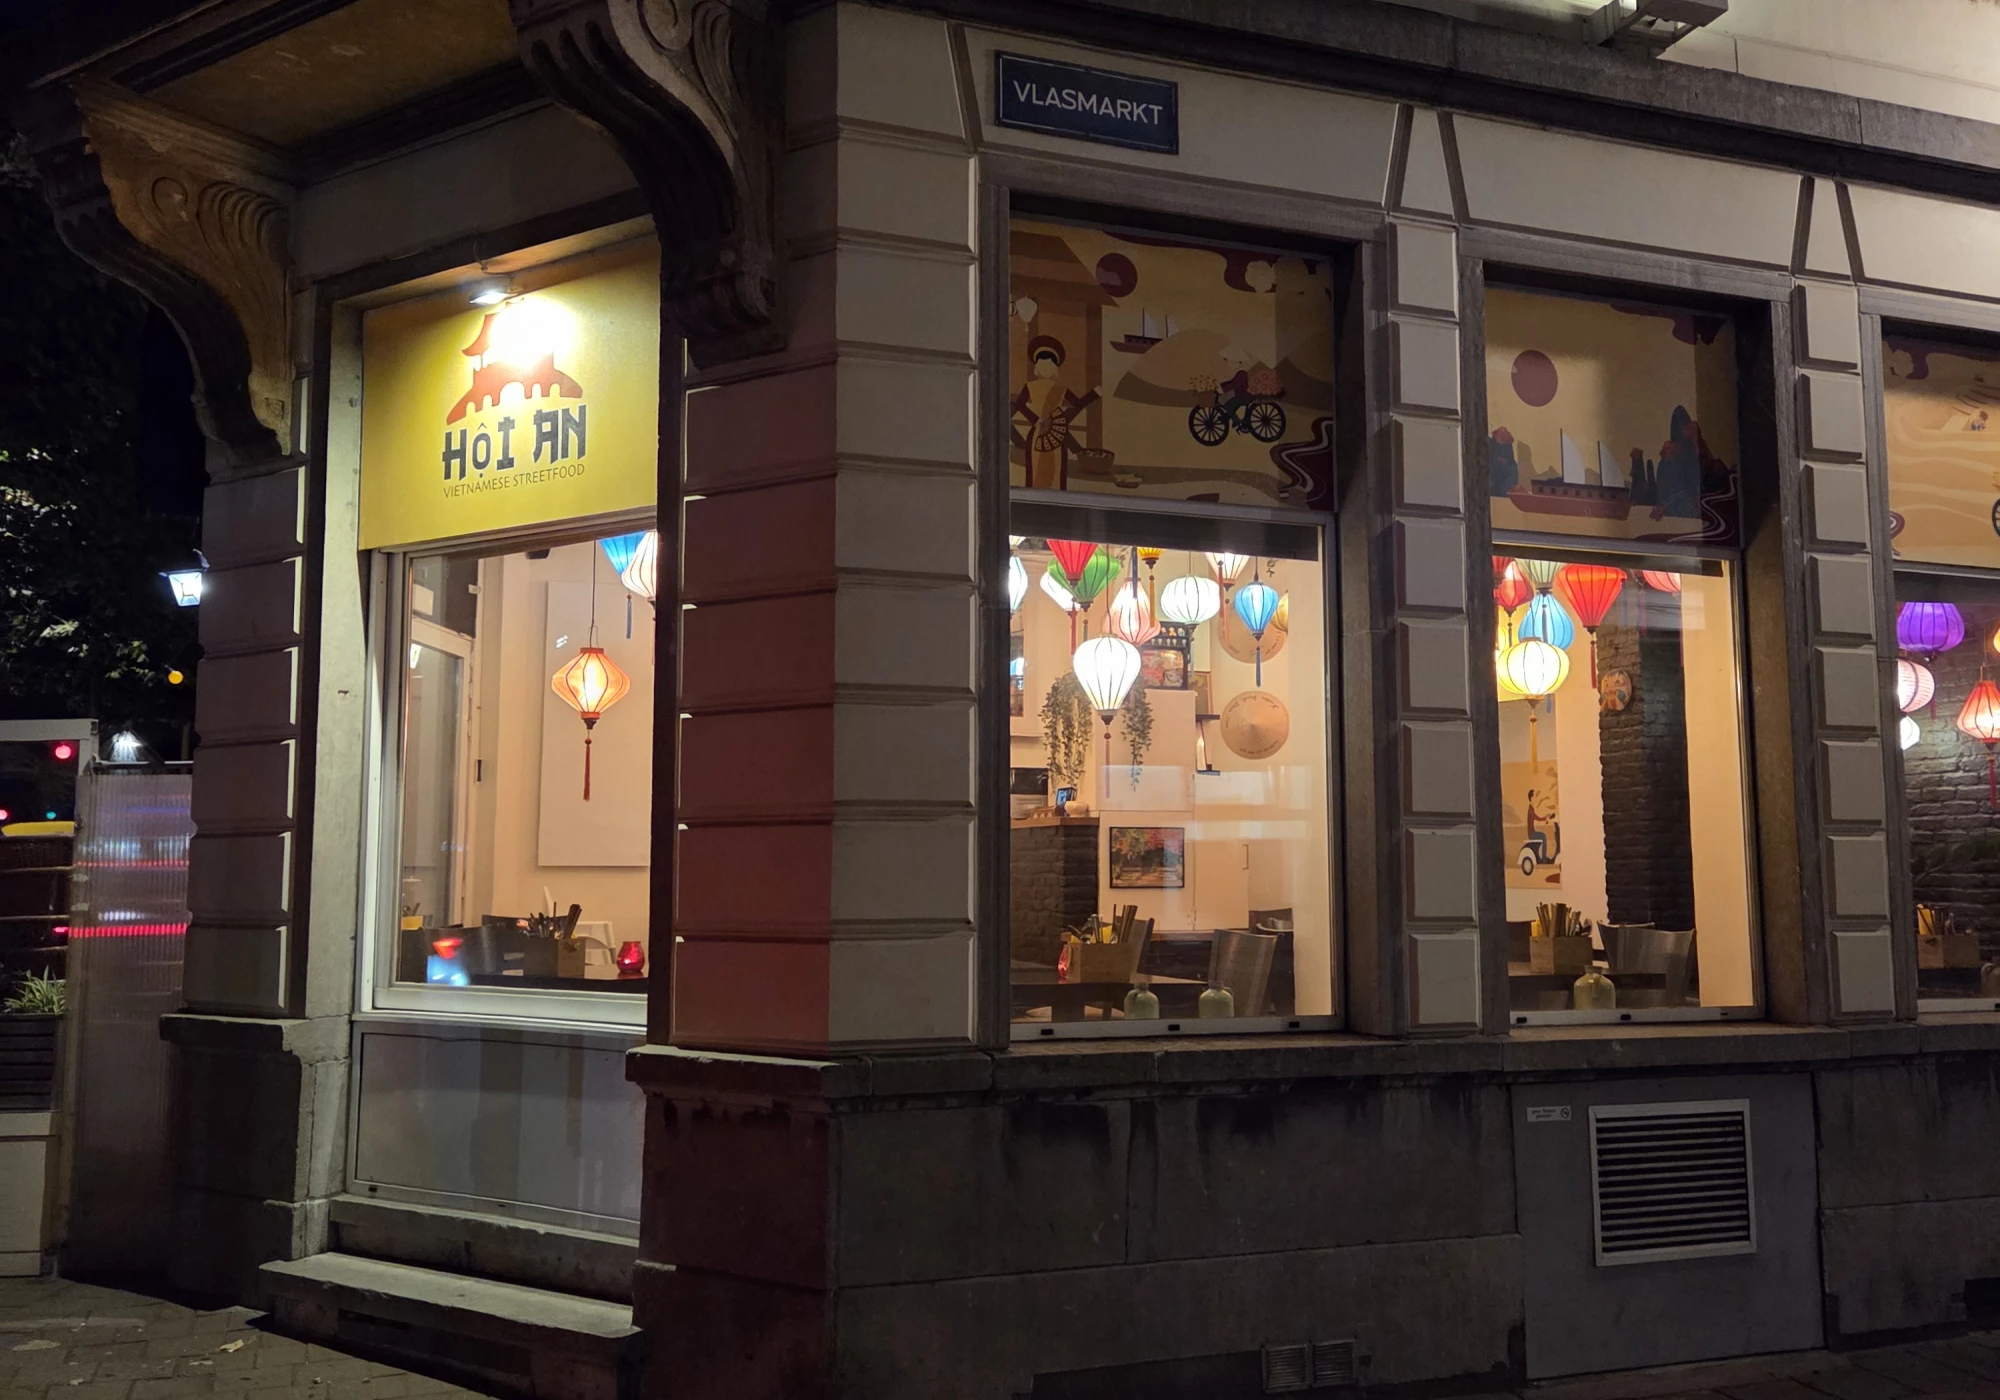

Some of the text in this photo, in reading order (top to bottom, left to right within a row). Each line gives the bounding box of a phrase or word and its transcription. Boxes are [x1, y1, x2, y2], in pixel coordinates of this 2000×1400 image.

[1013, 80, 1163, 125] VLASMARKT
[533, 404, 587, 463] AN
[443, 464, 585, 498] VIETNAMESE STREETFOOD
